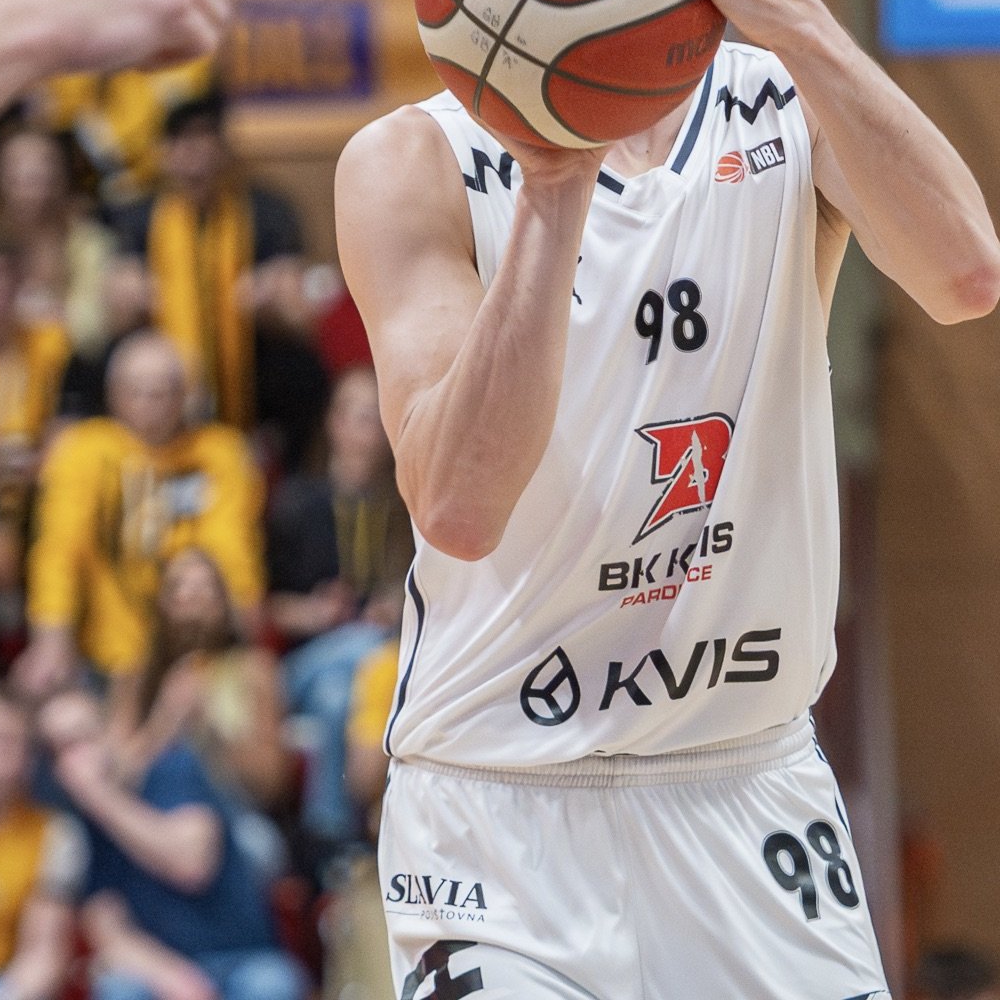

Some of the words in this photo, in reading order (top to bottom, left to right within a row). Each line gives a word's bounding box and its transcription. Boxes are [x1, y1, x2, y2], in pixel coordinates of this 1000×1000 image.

[750, 142, 785, 171] NBL
[634, 277, 709, 365] 98
[598, 553, 662, 591] BK
[598, 628, 782, 711] KVIS
[761, 819, 860, 921] 98
